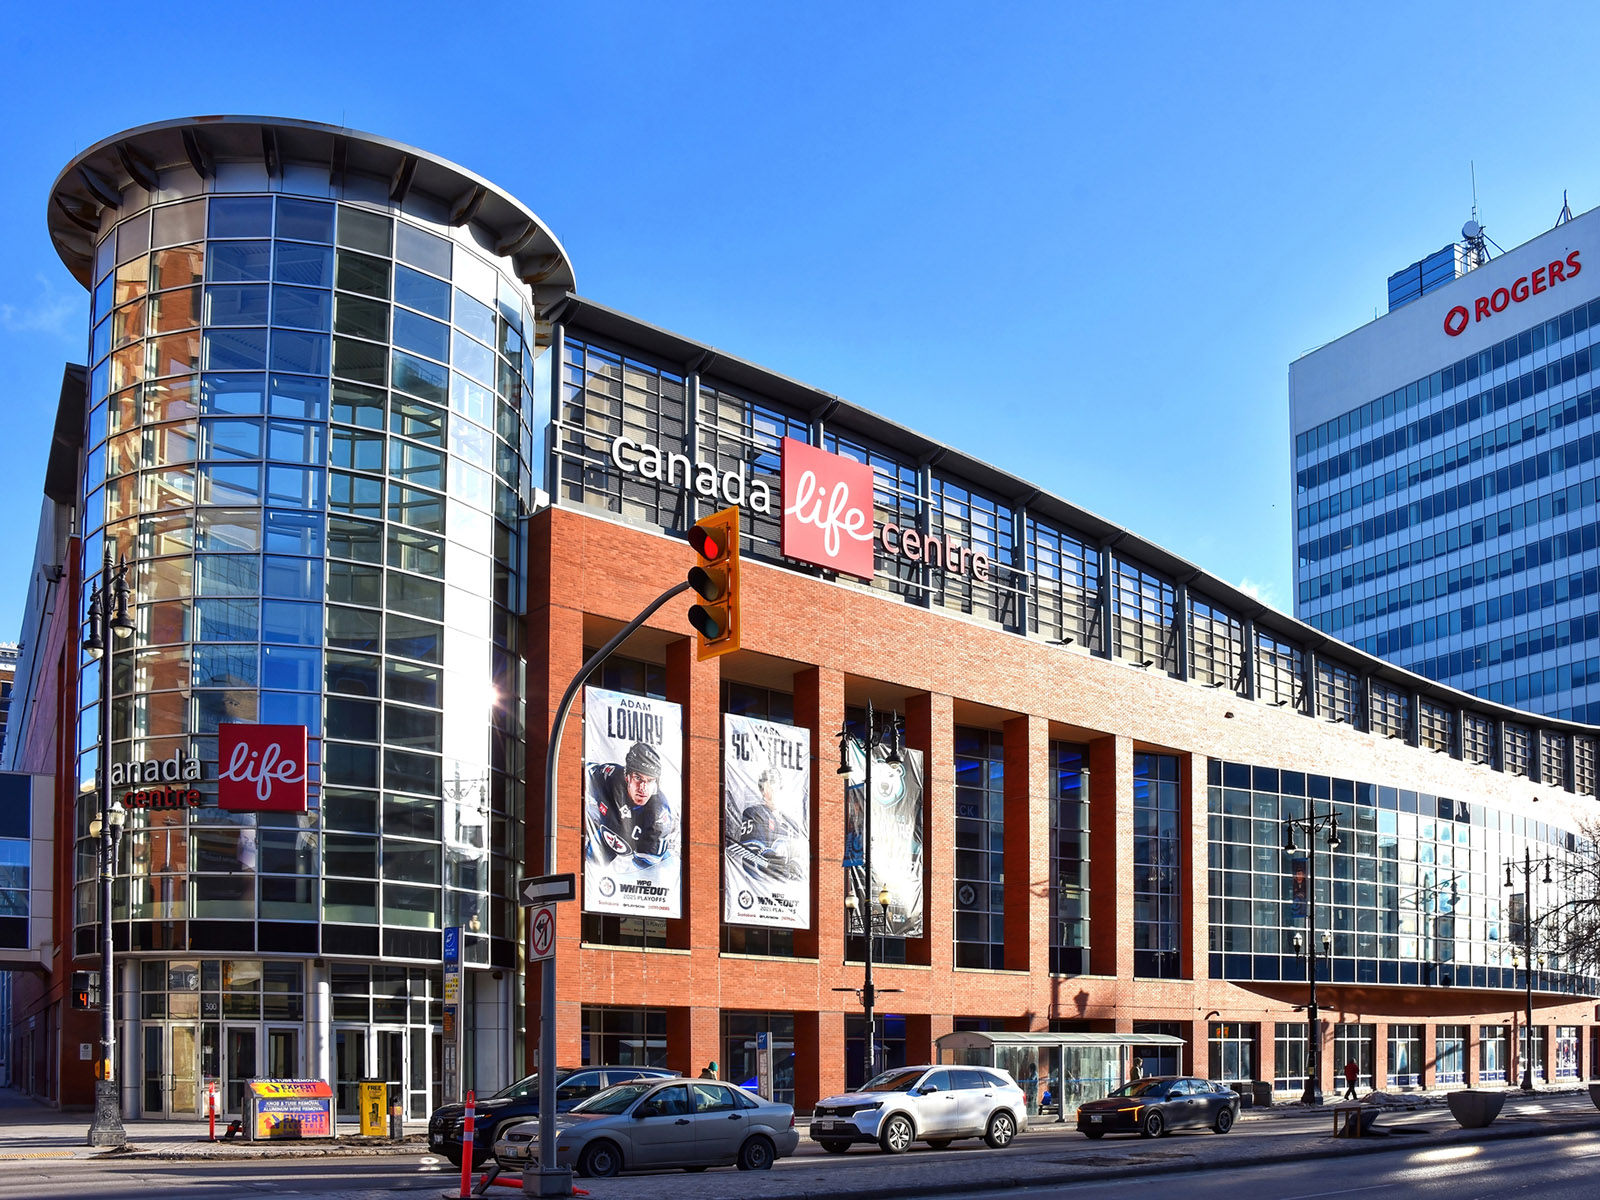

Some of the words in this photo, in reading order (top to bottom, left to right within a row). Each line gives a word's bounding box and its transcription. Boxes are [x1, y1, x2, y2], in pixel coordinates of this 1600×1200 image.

[1474, 250, 1582, 323] ROGERS
[611, 436, 771, 515] canada
[785, 470, 875, 558] life
[881, 523, 990, 582] centre
[620, 698, 651, 712] ADAM
[607, 706, 663, 746] LOWRY
[219, 741, 305, 801] life
[123, 787, 201, 809] centre
[631, 825, 642, 840] C
[620, 883, 668, 896] WHITEOUT
[637, 895, 666, 903] PLAYOFFS
[79, 993, 87, 1006] 4
[205, 1003, 217, 1011] 300
[284, 1114, 325, 1123] EXPERT
